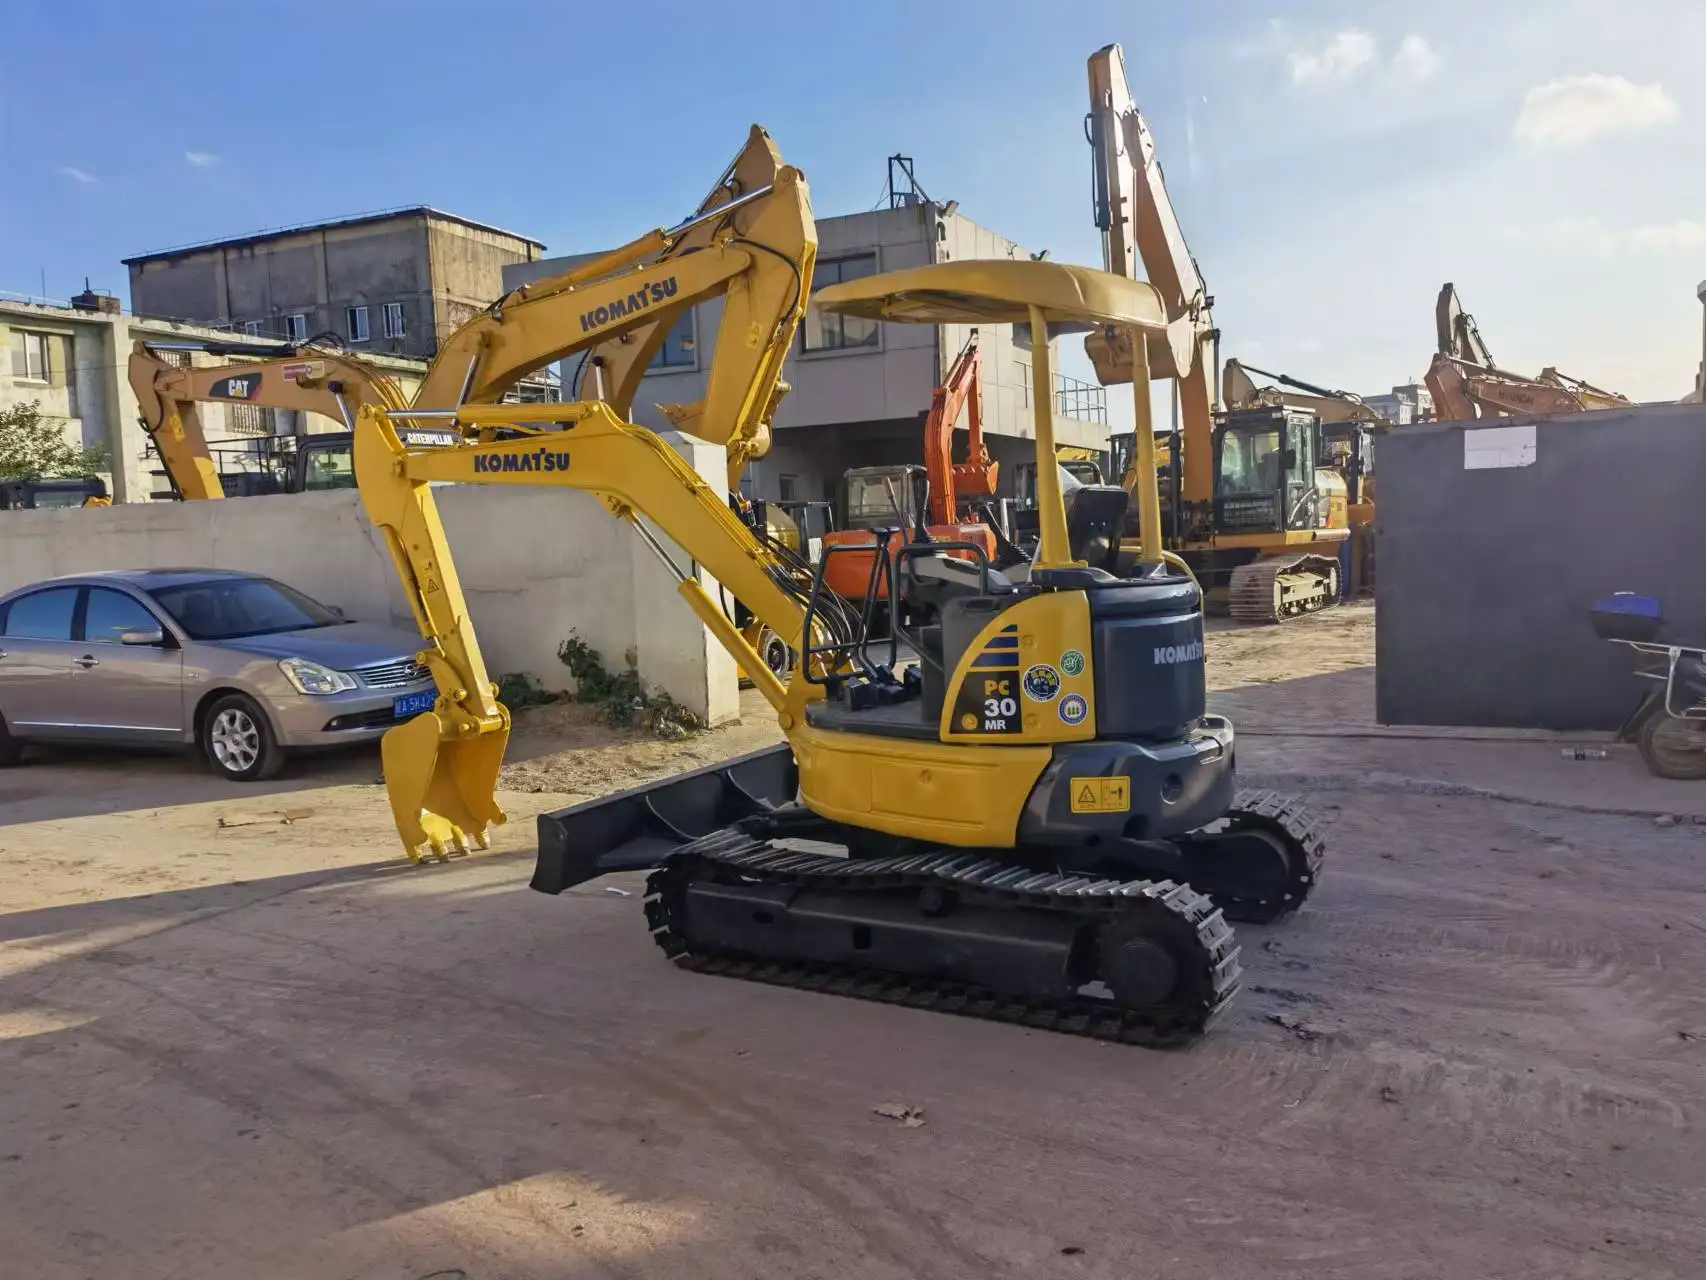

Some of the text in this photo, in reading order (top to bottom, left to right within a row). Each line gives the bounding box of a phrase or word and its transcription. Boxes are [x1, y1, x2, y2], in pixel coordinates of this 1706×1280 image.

[580, 276, 678, 332] KOMATSU
[229, 380, 249, 397] CAT
[407, 432, 454, 446] CATERPILLAR
[474, 447, 570, 473] KOMATSU
[984, 680, 1010, 696] PC
[984, 698, 1017, 717] 30
[985, 719, 1007, 730] MR
